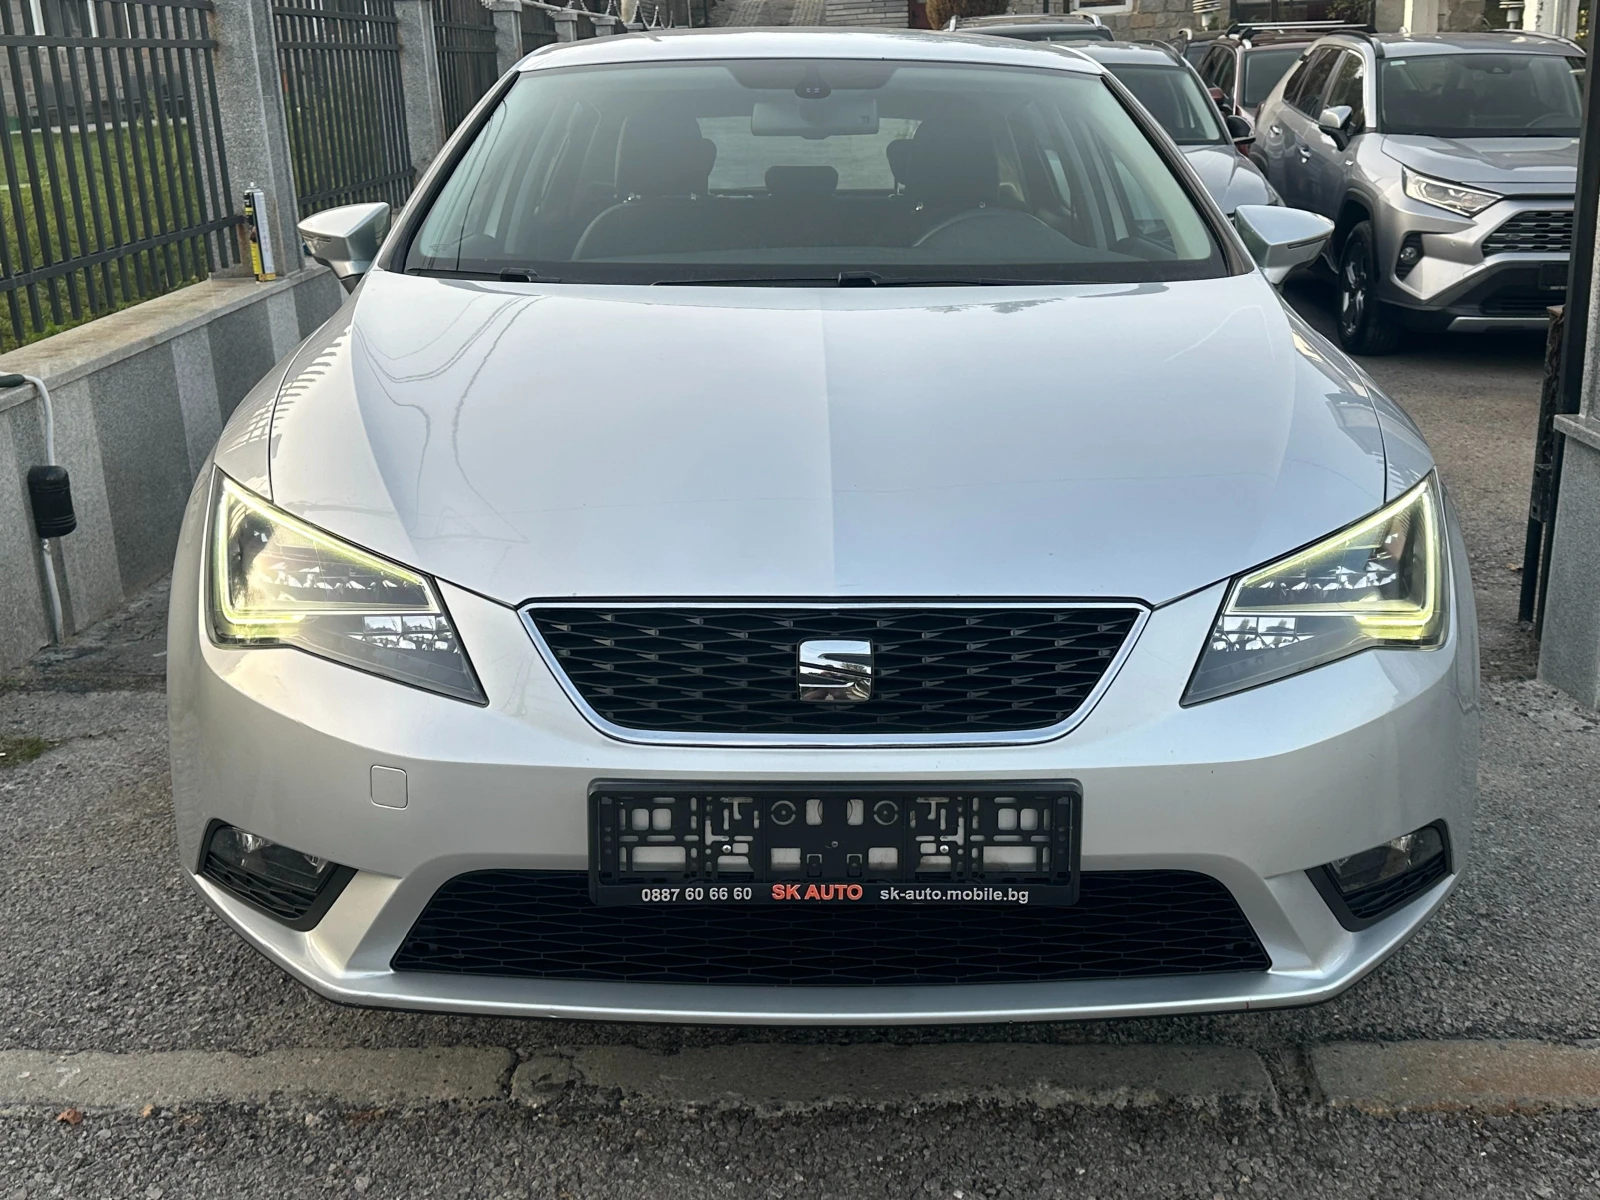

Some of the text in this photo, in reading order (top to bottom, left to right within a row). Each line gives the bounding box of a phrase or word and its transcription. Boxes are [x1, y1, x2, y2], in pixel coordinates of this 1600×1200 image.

[641, 884, 1029, 904] 0887 60 66 60 SK AUTO sk-auto.mobile.bg
